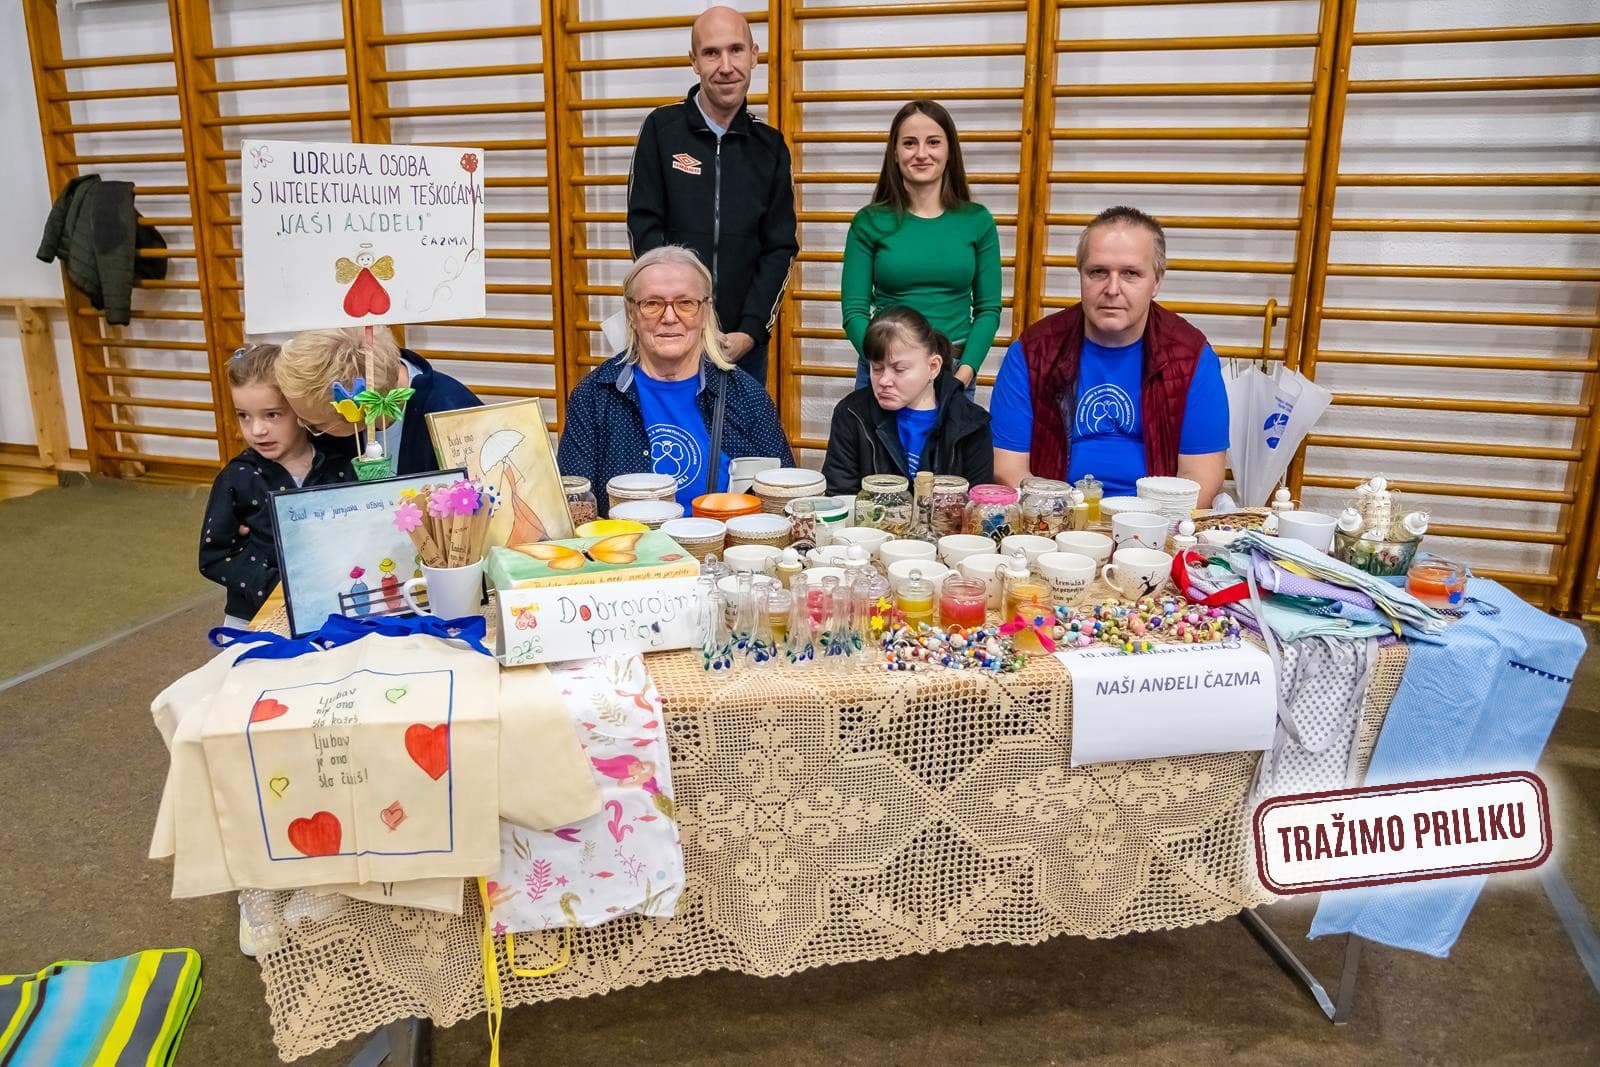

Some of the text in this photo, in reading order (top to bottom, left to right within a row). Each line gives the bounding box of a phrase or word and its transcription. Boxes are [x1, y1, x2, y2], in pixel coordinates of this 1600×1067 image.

[293, 151, 431, 177] UDRUGA OSOBA
[251, 182, 263, 204] S
[1096, 670, 1261, 696] NAŠI ANĐELI ČAZMA
[313, 732, 350, 757] Ljubav
